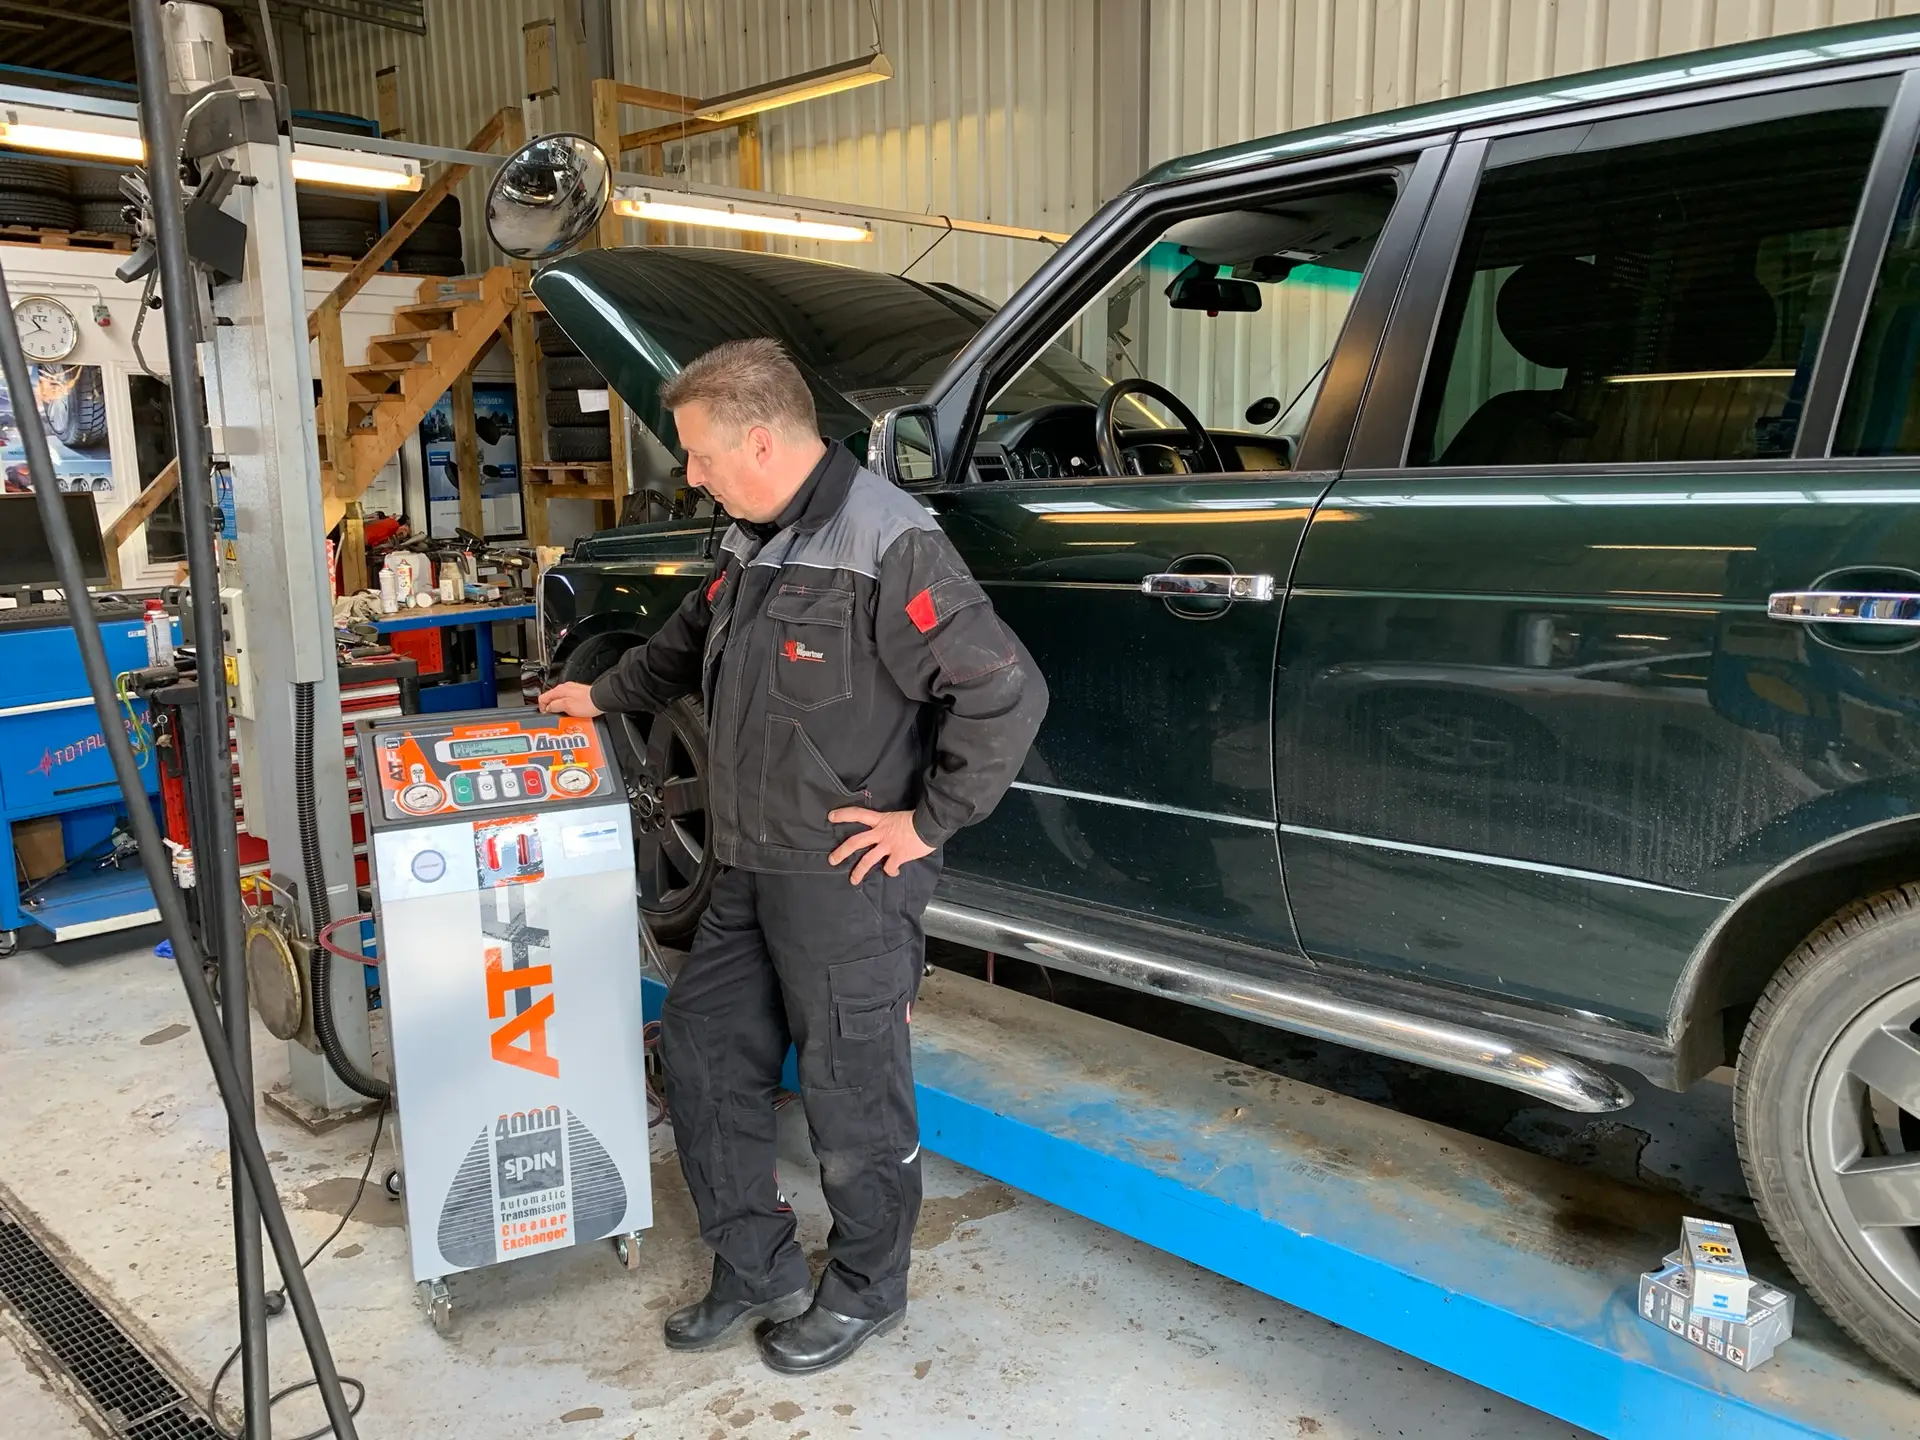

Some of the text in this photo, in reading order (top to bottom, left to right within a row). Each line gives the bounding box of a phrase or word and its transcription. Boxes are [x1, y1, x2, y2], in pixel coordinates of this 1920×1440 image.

[54, 733, 106, 766] TOTAL
[535, 734, 588, 751] 4000
[385, 750, 406, 782] ATF
[478, 885, 560, 1079] ATF
[495, 1105, 561, 1139] 4000
[500, 1190, 566, 1212] Automatic
[501, 1201, 567, 1222] Transmission
[502, 1214, 568, 1237] Cleaner
[503, 1228, 568, 1252] Exchanger
